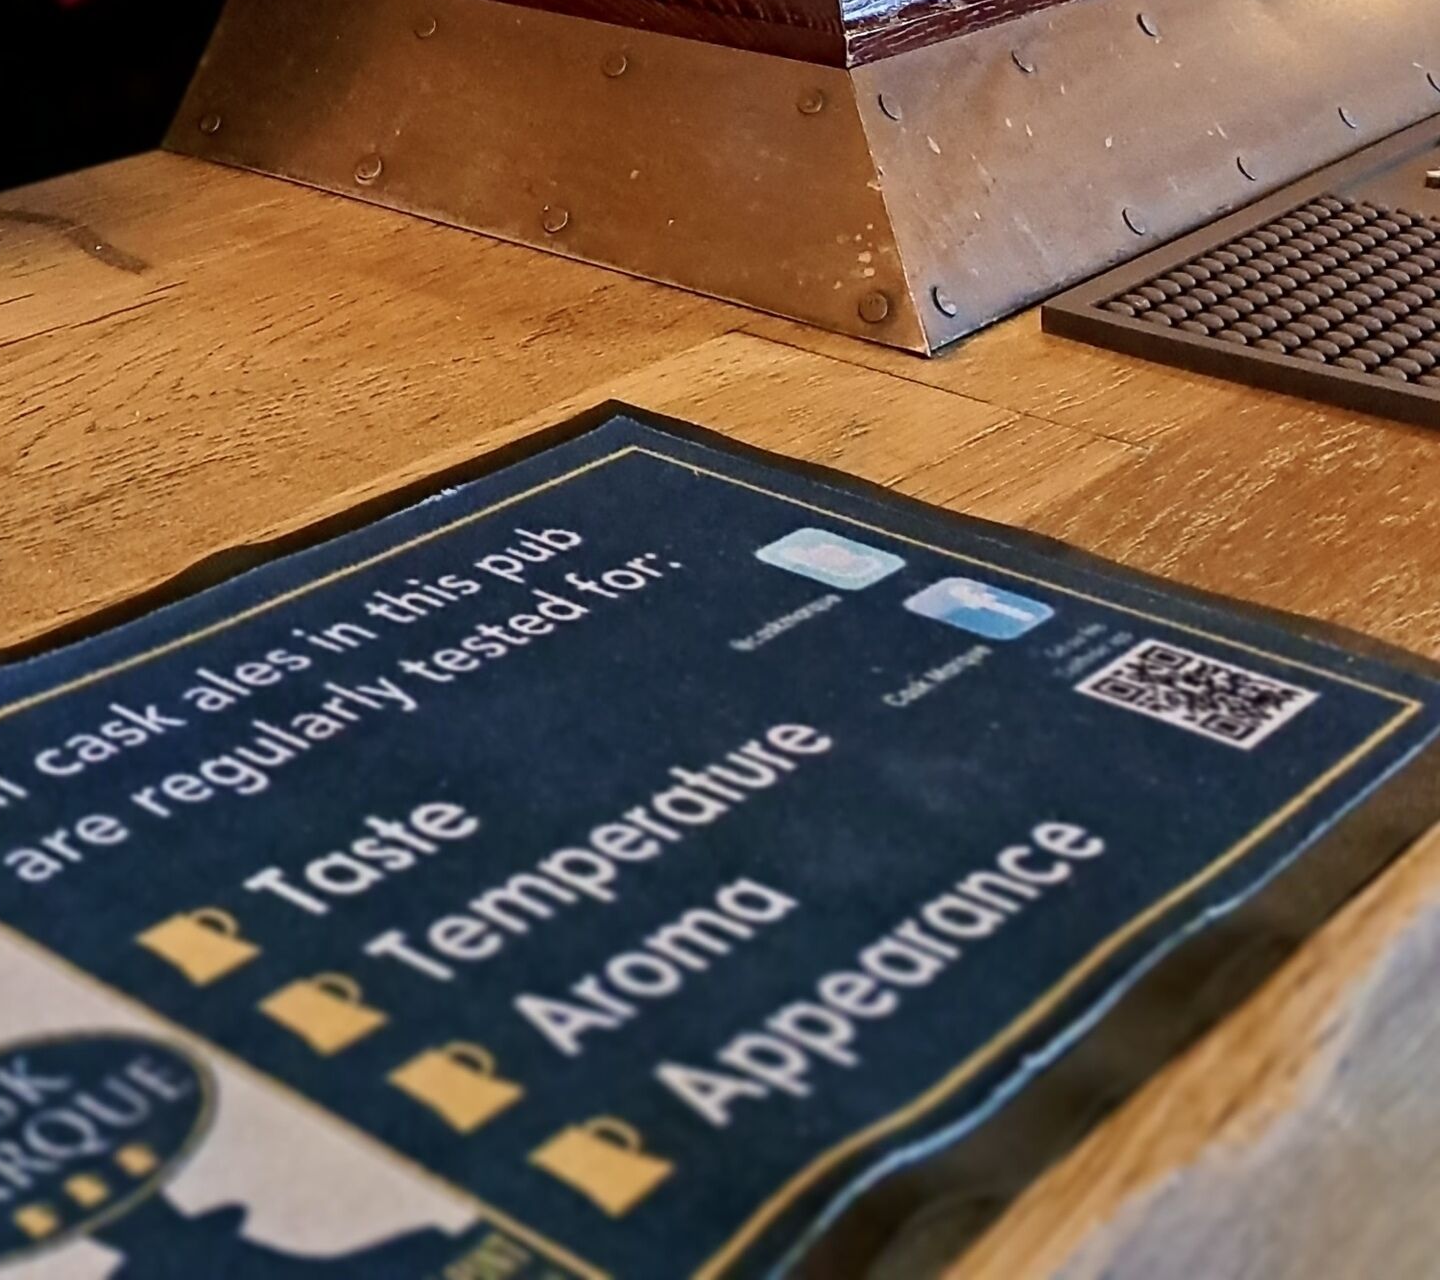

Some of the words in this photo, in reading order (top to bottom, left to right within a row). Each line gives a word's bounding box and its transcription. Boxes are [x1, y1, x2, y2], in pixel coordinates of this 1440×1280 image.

[2, 810, 132, 886] are
[130, 670, 422, 819] regularly
[404, 590, 592, 687] tested
[565, 548, 685, 601] for:
[32, 699, 190, 780] cask
[182, 642, 315, 717] ales
[302, 613, 380, 657] in
[363, 568, 483, 629] this
[472, 521, 586, 586] pub
[243, 794, 483, 918] Taste
[363, 713, 837, 984] Temperature
[513, 874, 800, 1056] Aroma
[654, 817, 1109, 1129] Appearance
